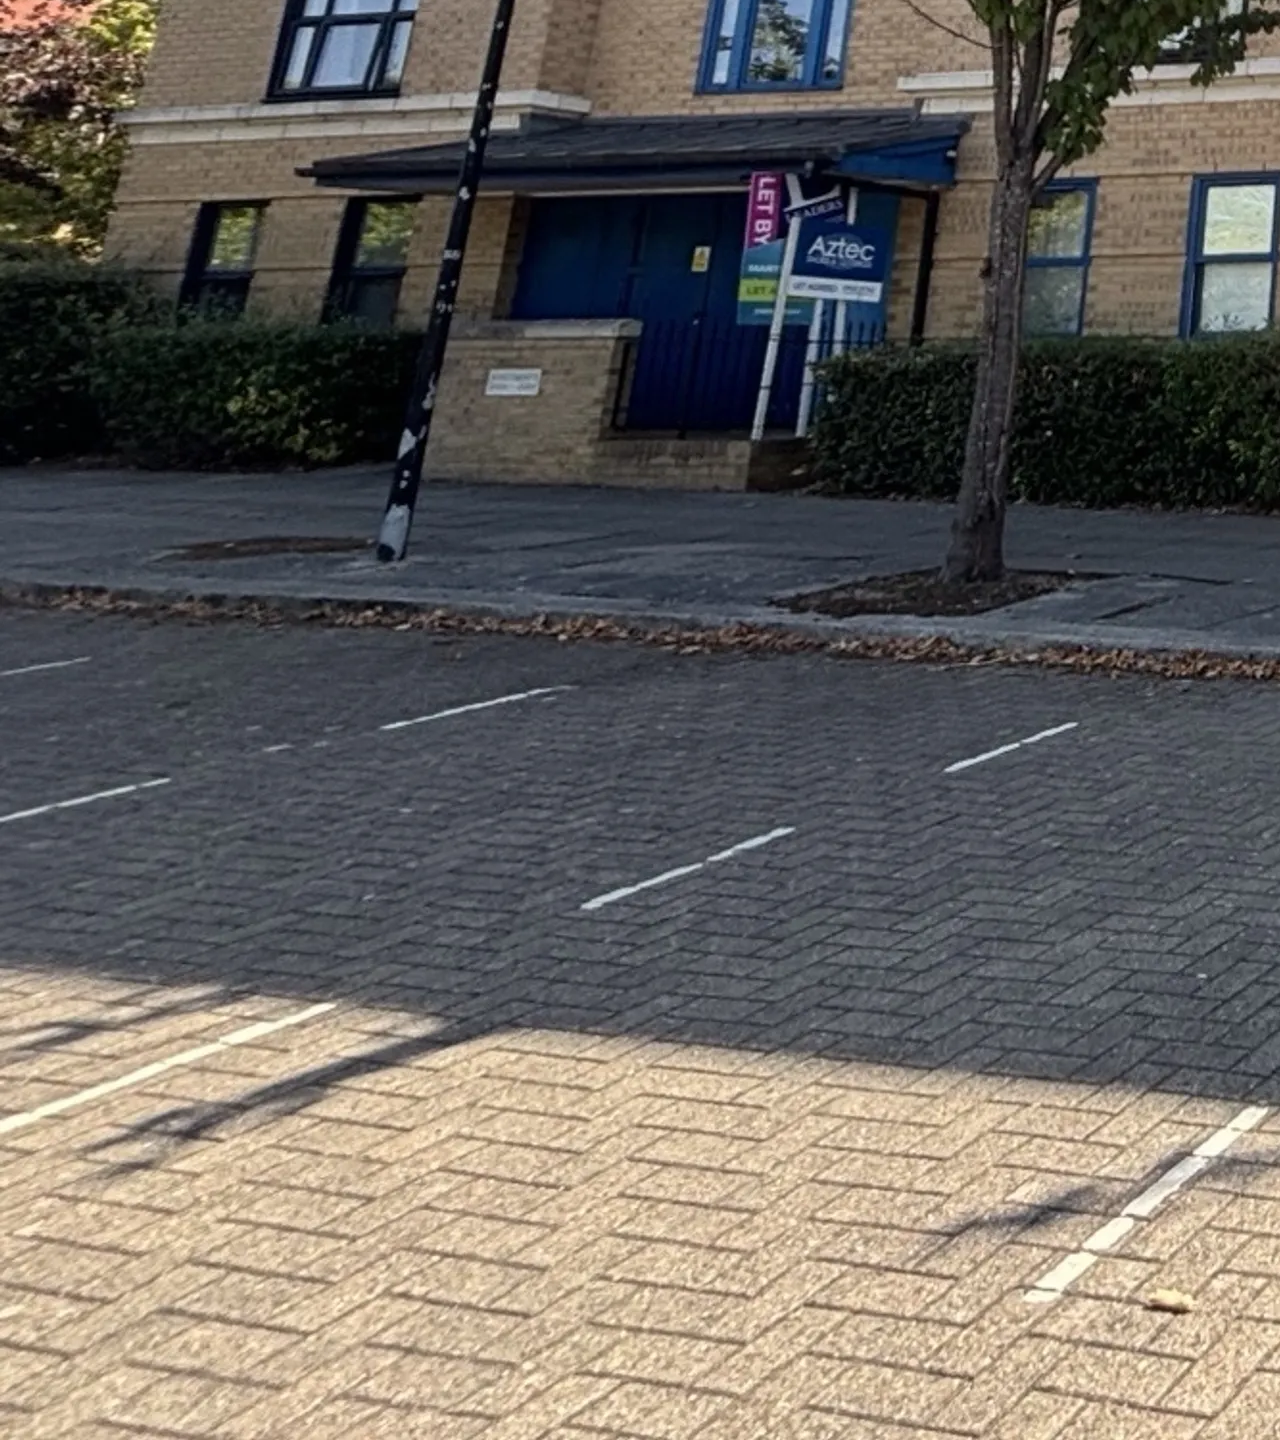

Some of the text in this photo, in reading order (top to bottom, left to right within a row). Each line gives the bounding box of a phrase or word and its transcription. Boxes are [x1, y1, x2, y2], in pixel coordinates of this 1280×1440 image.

[753, 177, 776, 246] LET BY
[807, 235, 876, 262] Aztec
[747, 286, 765, 295] LET
